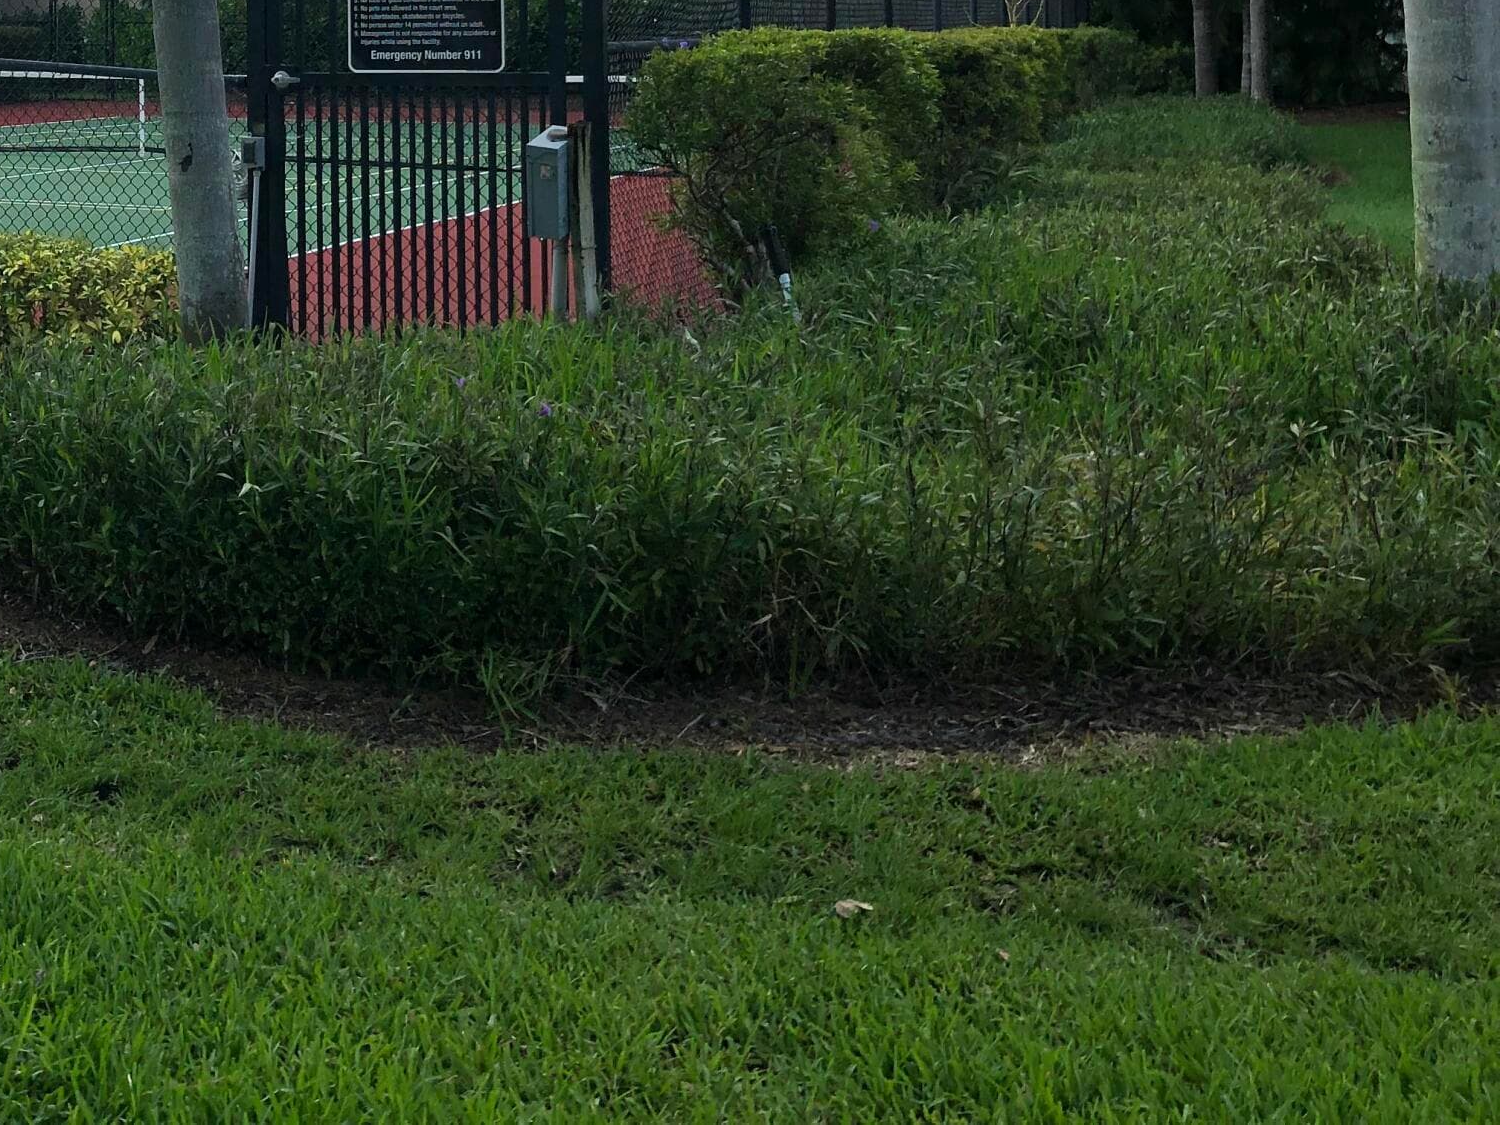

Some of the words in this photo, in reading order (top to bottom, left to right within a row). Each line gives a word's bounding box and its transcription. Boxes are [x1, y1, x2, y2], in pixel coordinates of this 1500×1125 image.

[370, 49, 422, 61] Emergency
[424, 49, 462, 60] Number
[464, 49, 481, 60] 911
